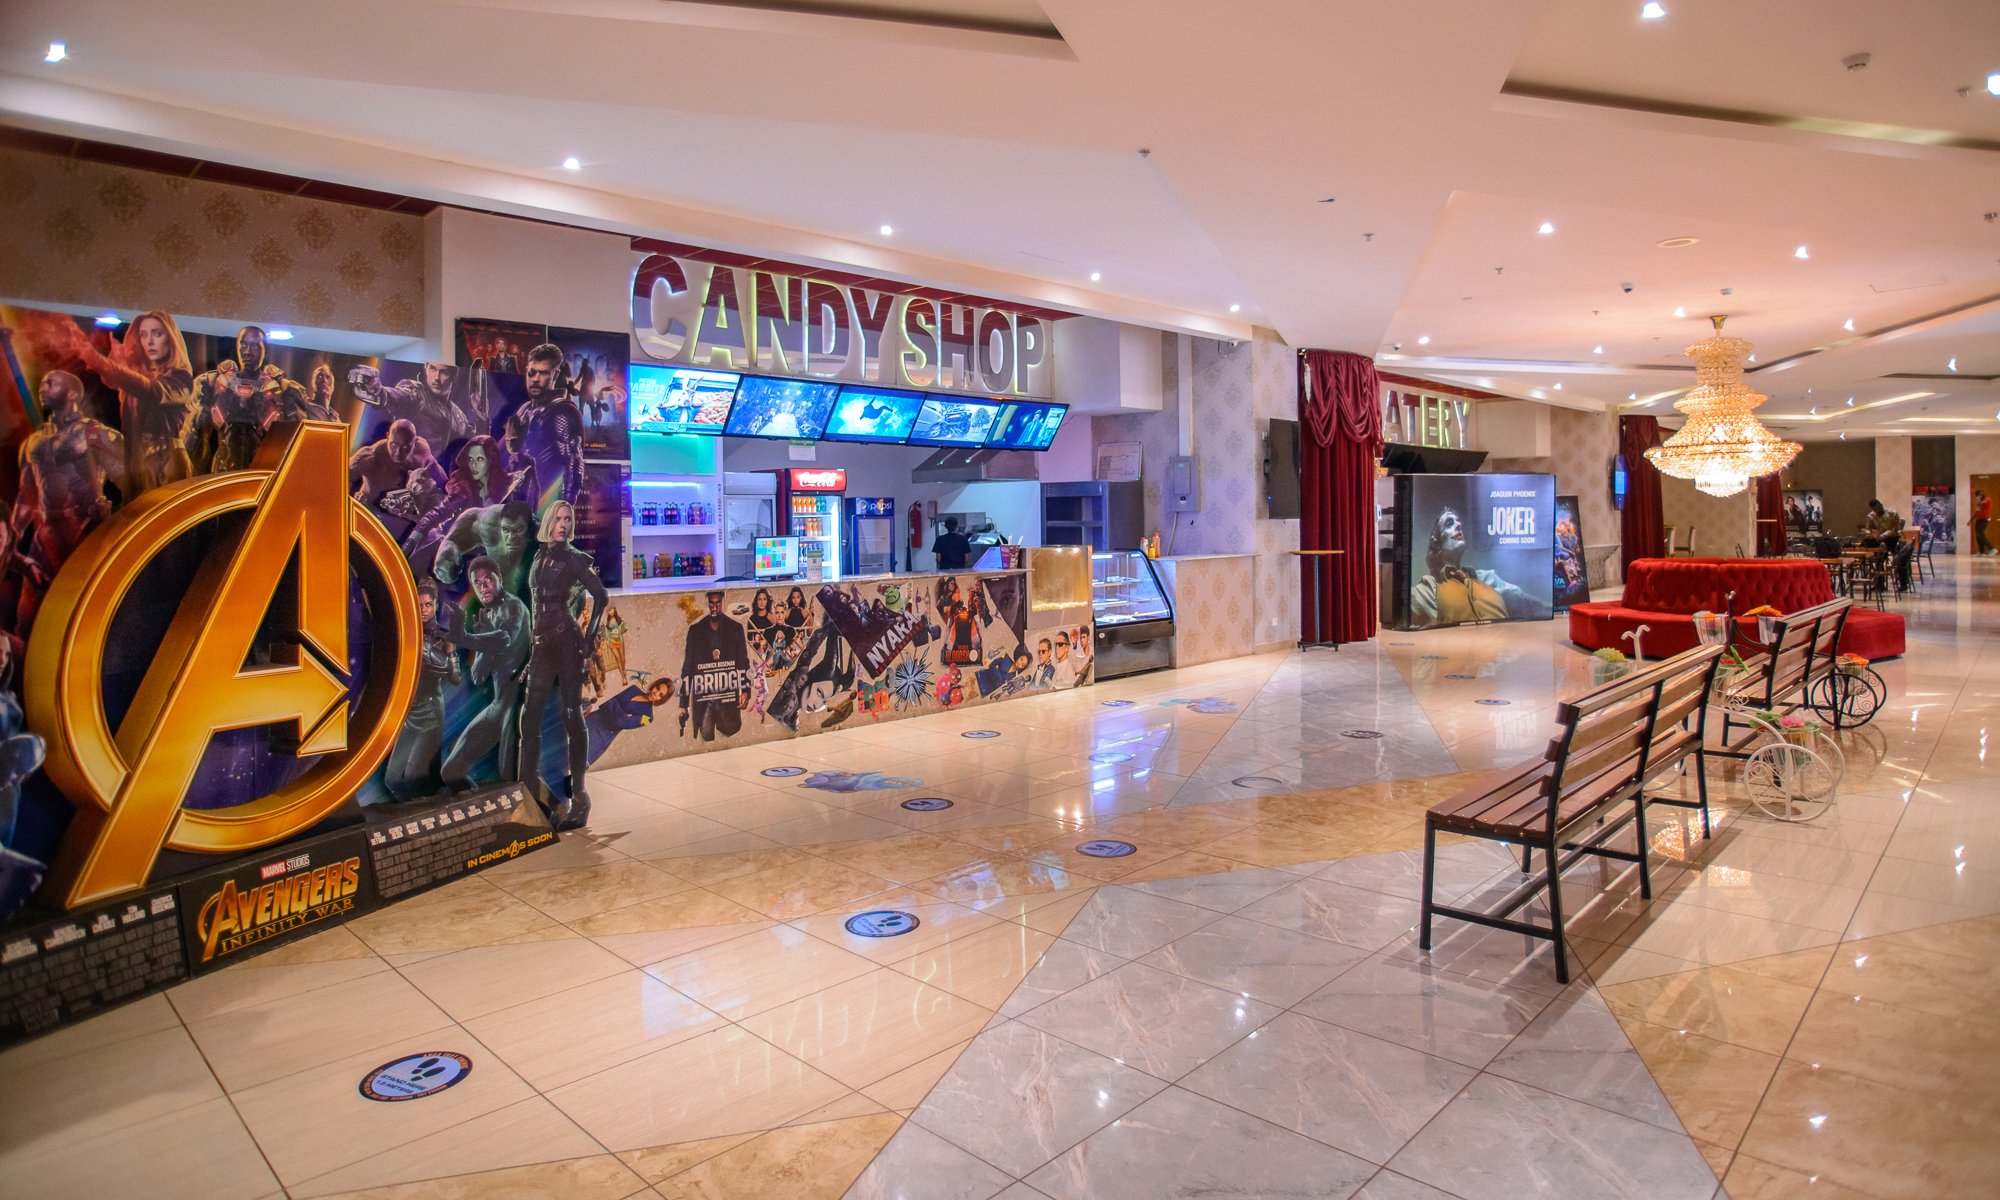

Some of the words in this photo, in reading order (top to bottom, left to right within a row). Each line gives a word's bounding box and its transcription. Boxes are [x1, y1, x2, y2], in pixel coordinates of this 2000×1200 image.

[630, 253, 896, 378] CANDY
[901, 296, 1045, 393] SHOP
[1383, 390, 1470, 449] ATERY
[1513, 490, 1536, 498] PHOENIX
[1487, 506, 1535, 536] JOKER
[1520, 536, 1535, 544] SOON
[697, 662, 717, 670] CHADWICK
[717, 660, 736, 668] BOSEMAN
[694, 668, 755, 695] BRIDGES
[467, 858, 478, 868] IN
[479, 840, 526, 864] CINEMAS
[527, 832, 553, 847] SOON
[262, 862, 286, 879] MARVEL
[286, 854, 310, 871] STUDIOS
[197, 856, 361, 962] AVENGERS
[221, 913, 308, 953] INFINITY
[316, 897, 354, 916] WAR
[380, 1074, 407, 1086] STAND
[407, 1081, 427, 1091] HERE
[387, 1082, 413, 1094] METERS
